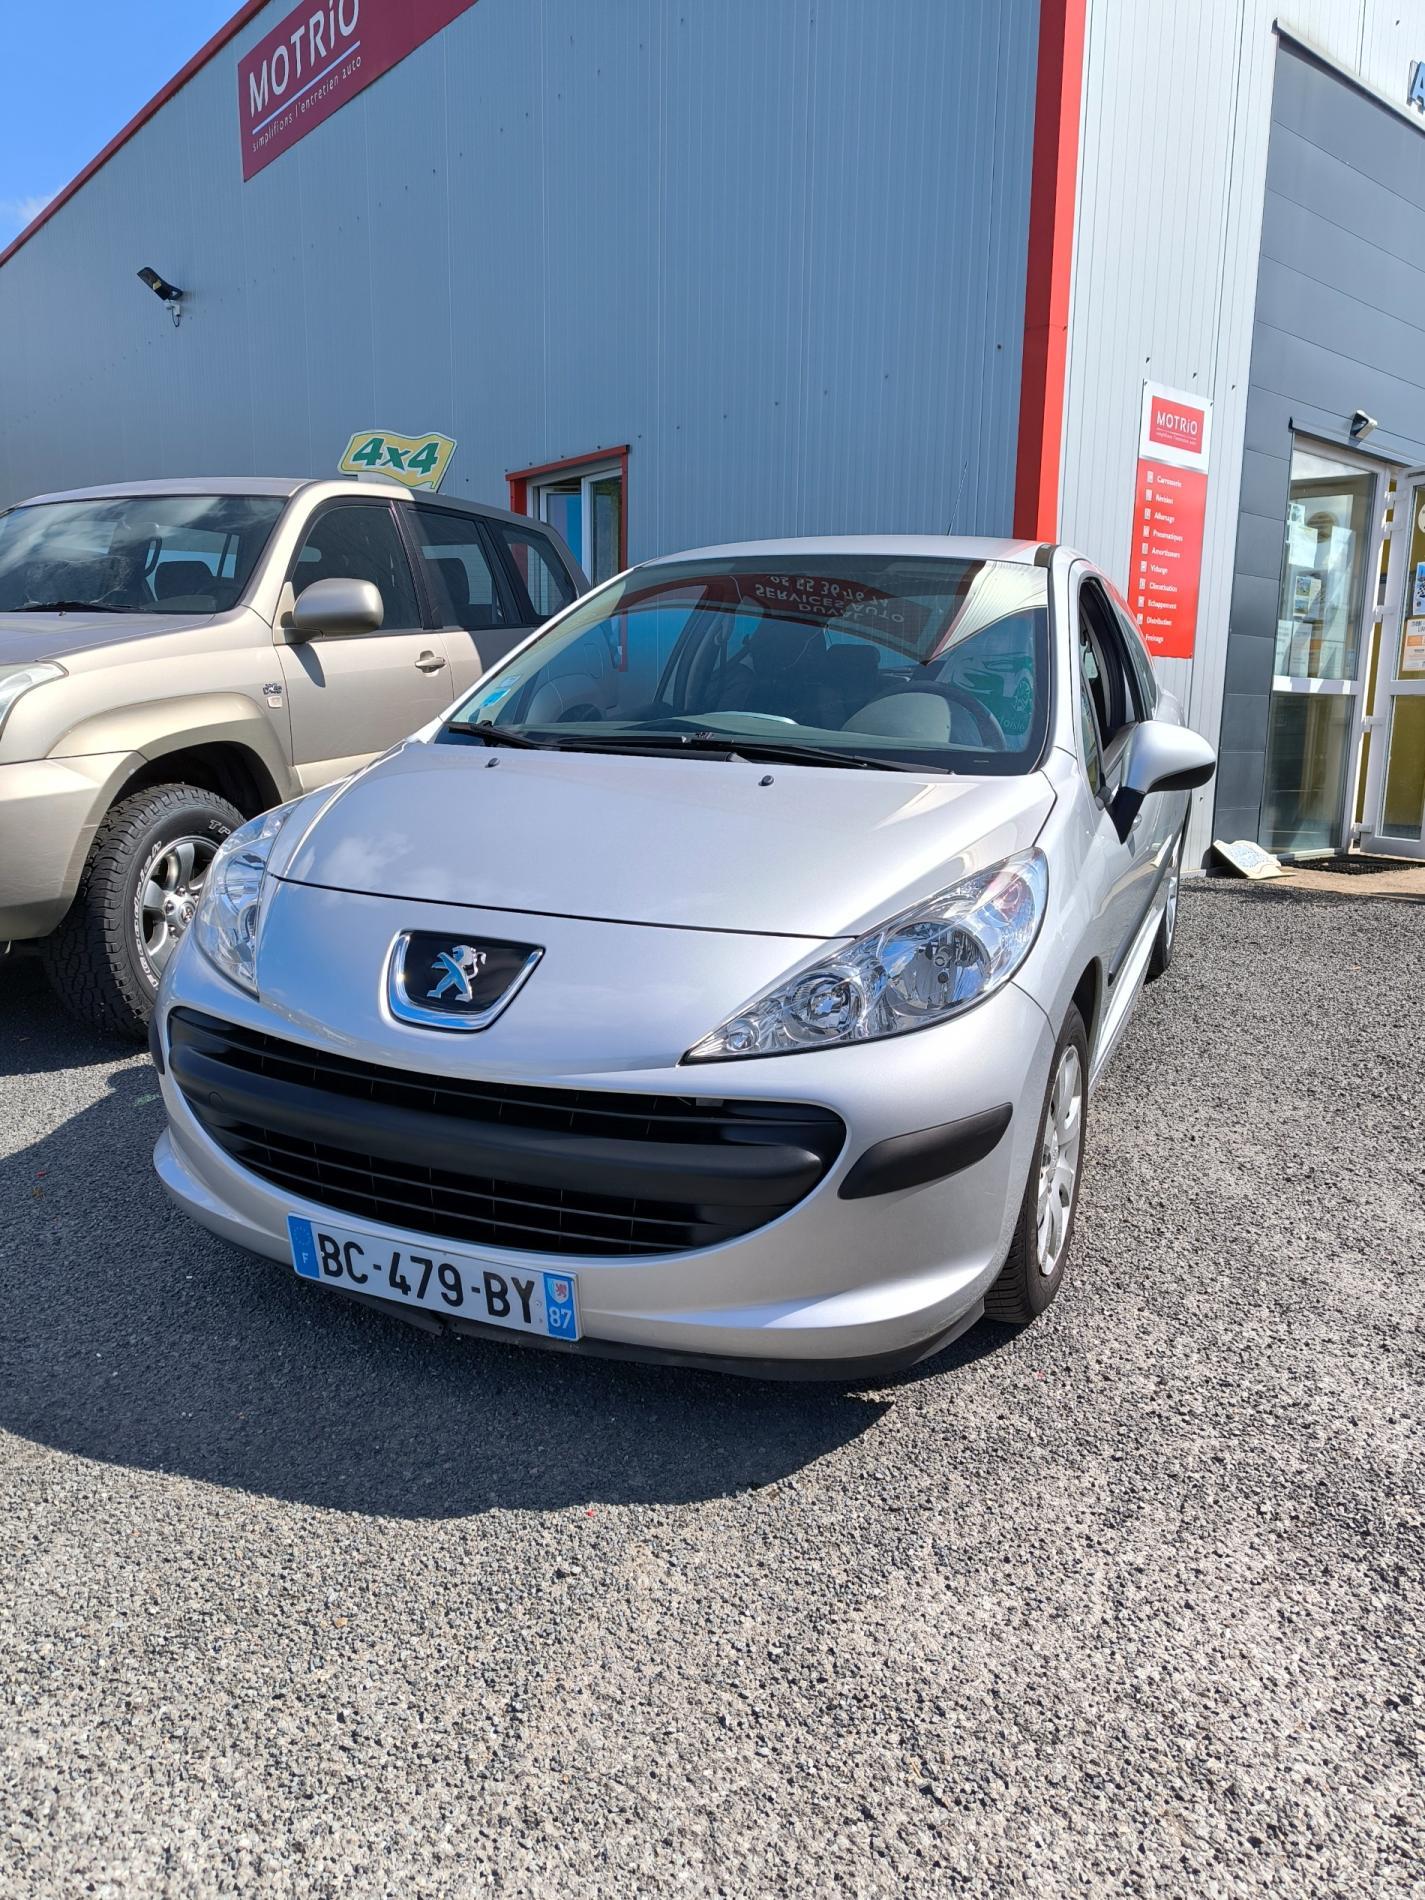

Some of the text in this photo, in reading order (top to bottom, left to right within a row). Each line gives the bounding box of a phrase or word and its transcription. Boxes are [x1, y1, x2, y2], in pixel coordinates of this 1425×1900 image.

[252, 56, 362, 152] simplifions l'entretien auto
[351, 437, 440, 475] 4x4
[133, 840, 162, 990] FGoodrich
[317, 1232, 536, 1325] BC-479-BY
[549, 1307, 572, 1329] 87
